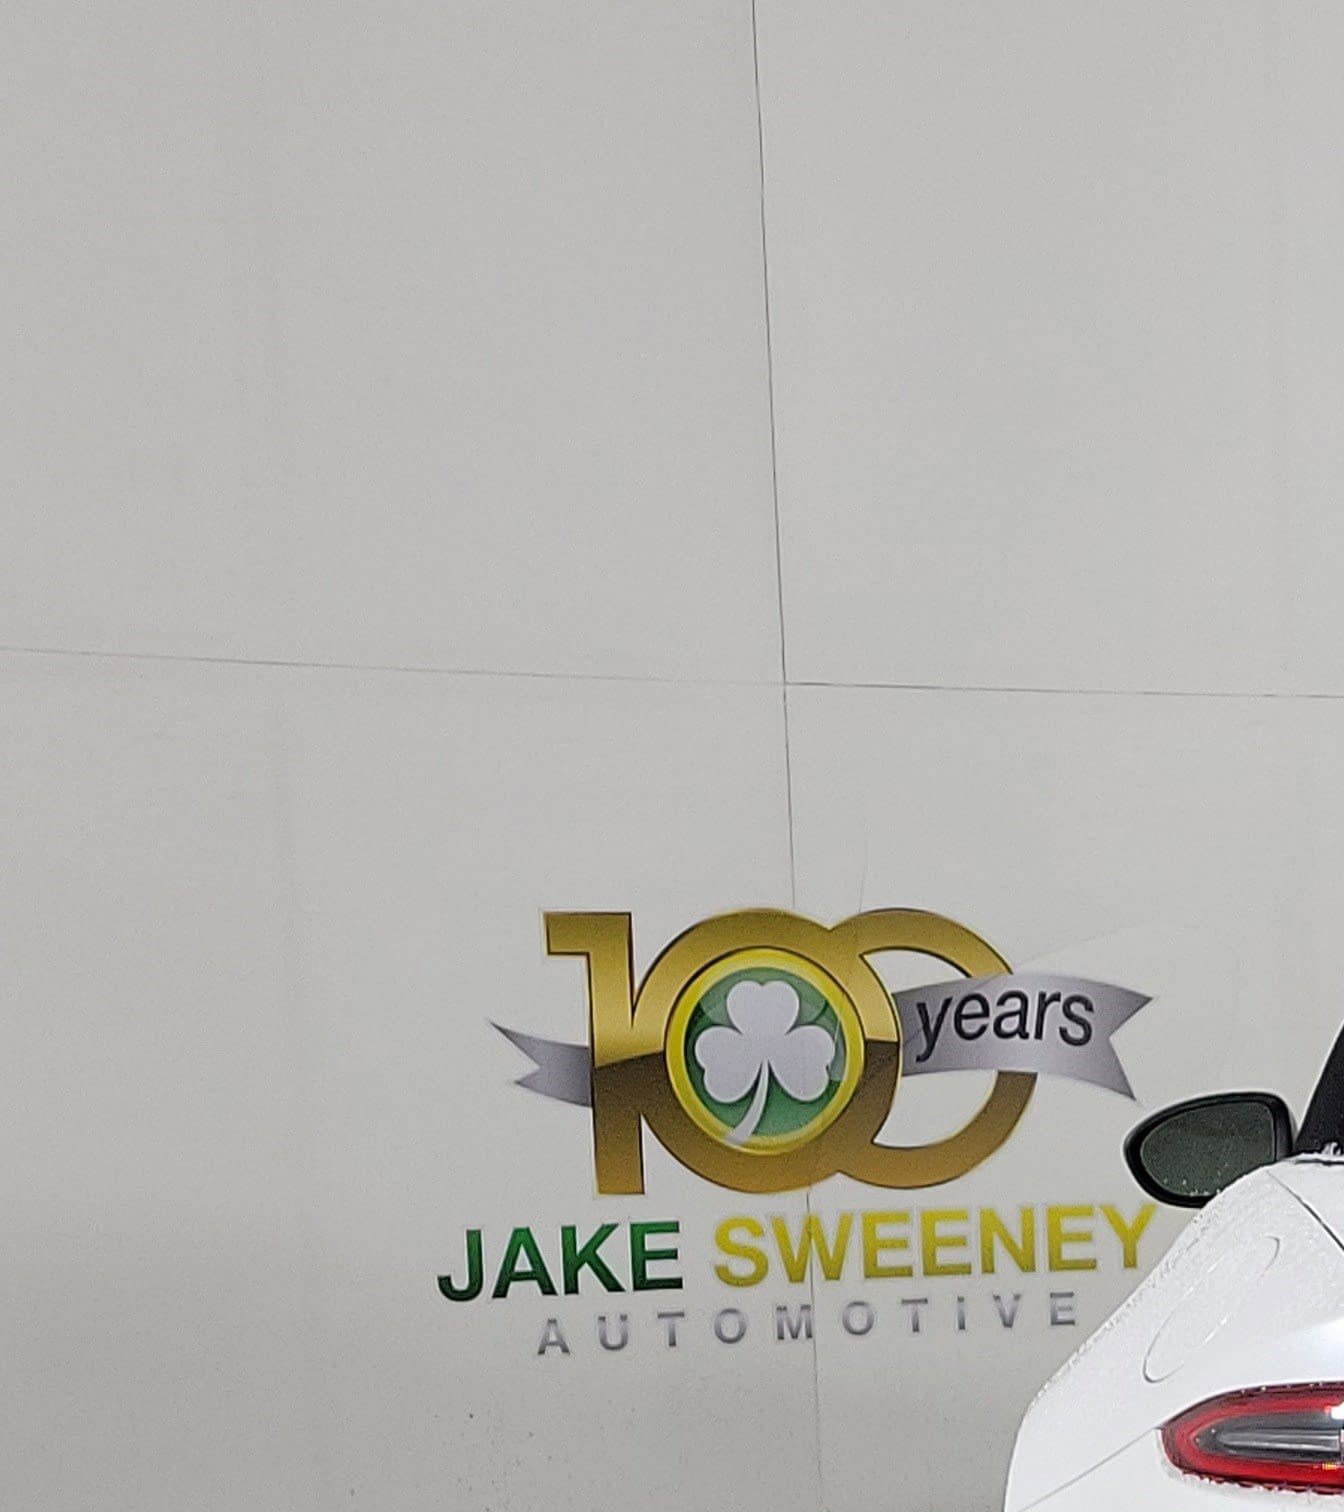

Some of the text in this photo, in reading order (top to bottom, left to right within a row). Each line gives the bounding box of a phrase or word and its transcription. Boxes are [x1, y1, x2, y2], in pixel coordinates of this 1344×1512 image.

[543, 907, 1095, 1195] 100 years
[437, 1203, 1156, 1301] JAKE SWEENEY
[537, 1291, 1077, 1356] AUTOMOTIVE
